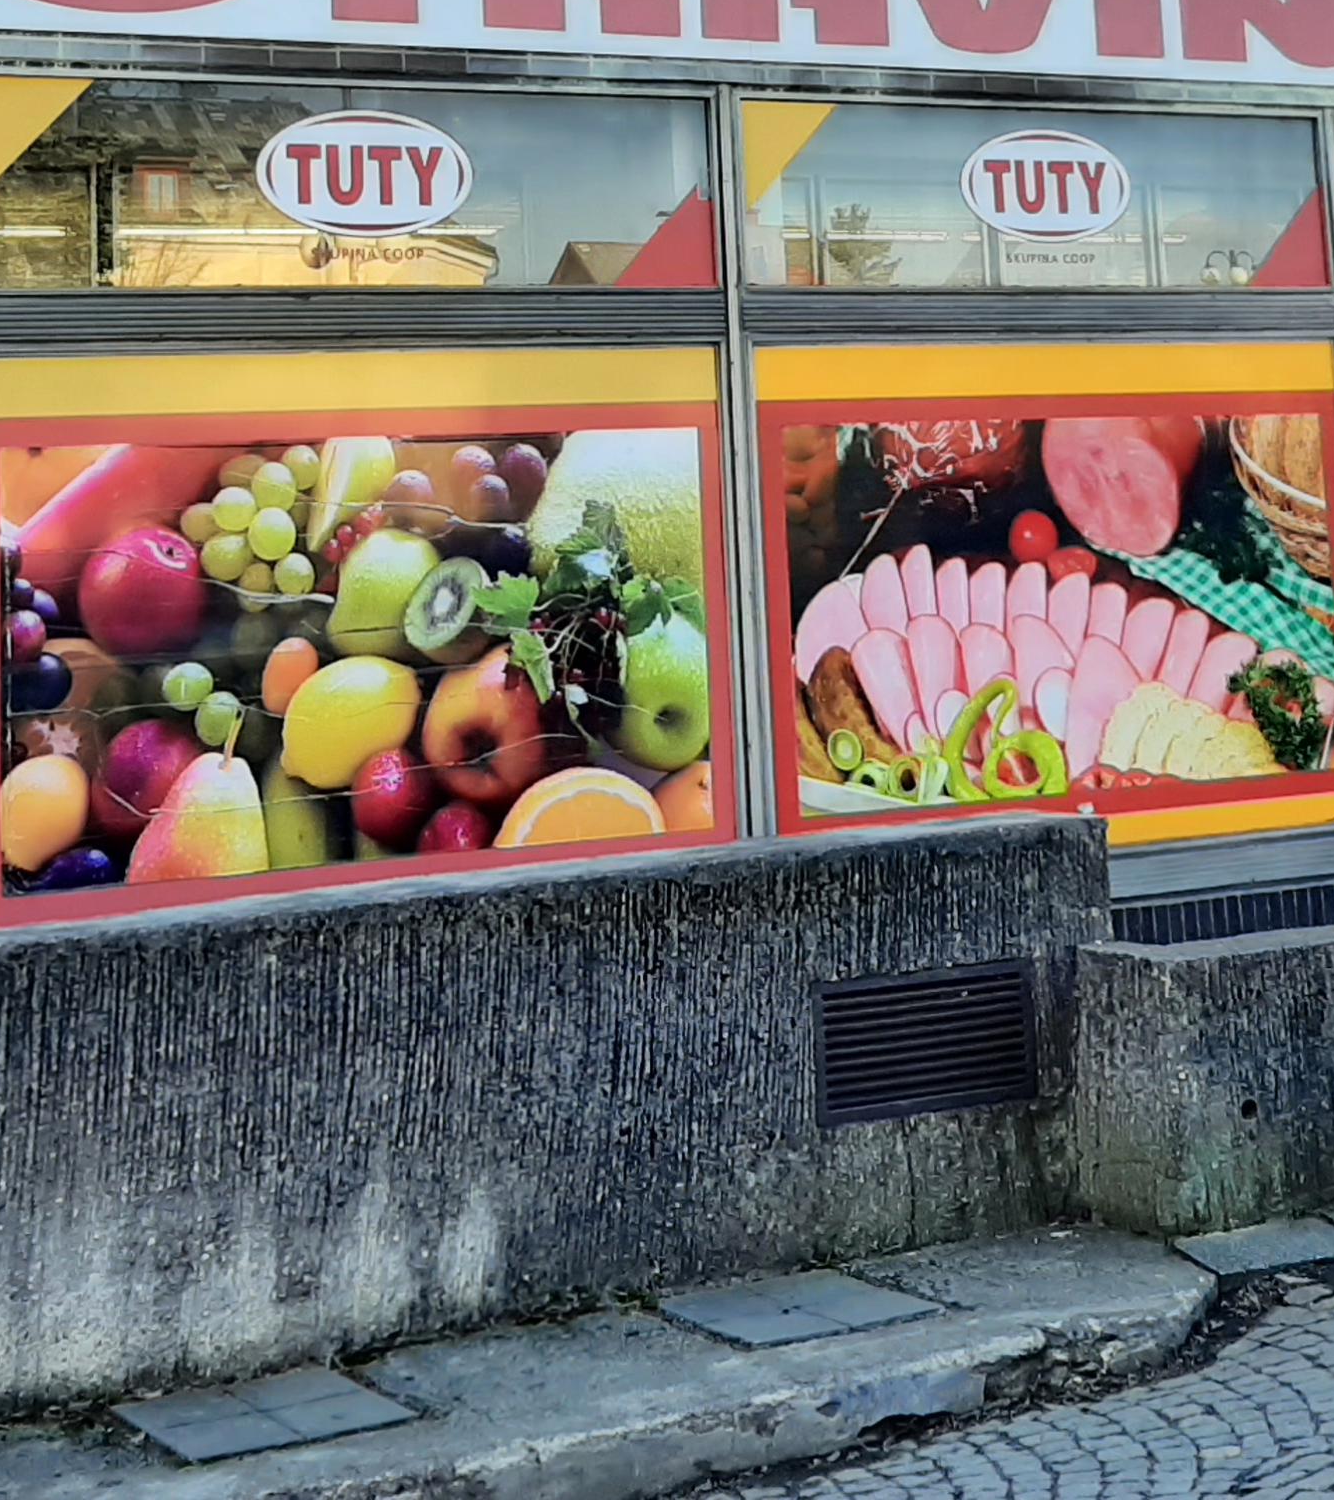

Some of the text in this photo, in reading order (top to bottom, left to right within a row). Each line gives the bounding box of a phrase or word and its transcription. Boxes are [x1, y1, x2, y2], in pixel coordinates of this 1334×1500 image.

[285, 143, 444, 207] TUTY
[982, 159, 1107, 215] TUTY
[382, 247, 425, 261] COOP
[1062, 253, 1096, 264] COOP
